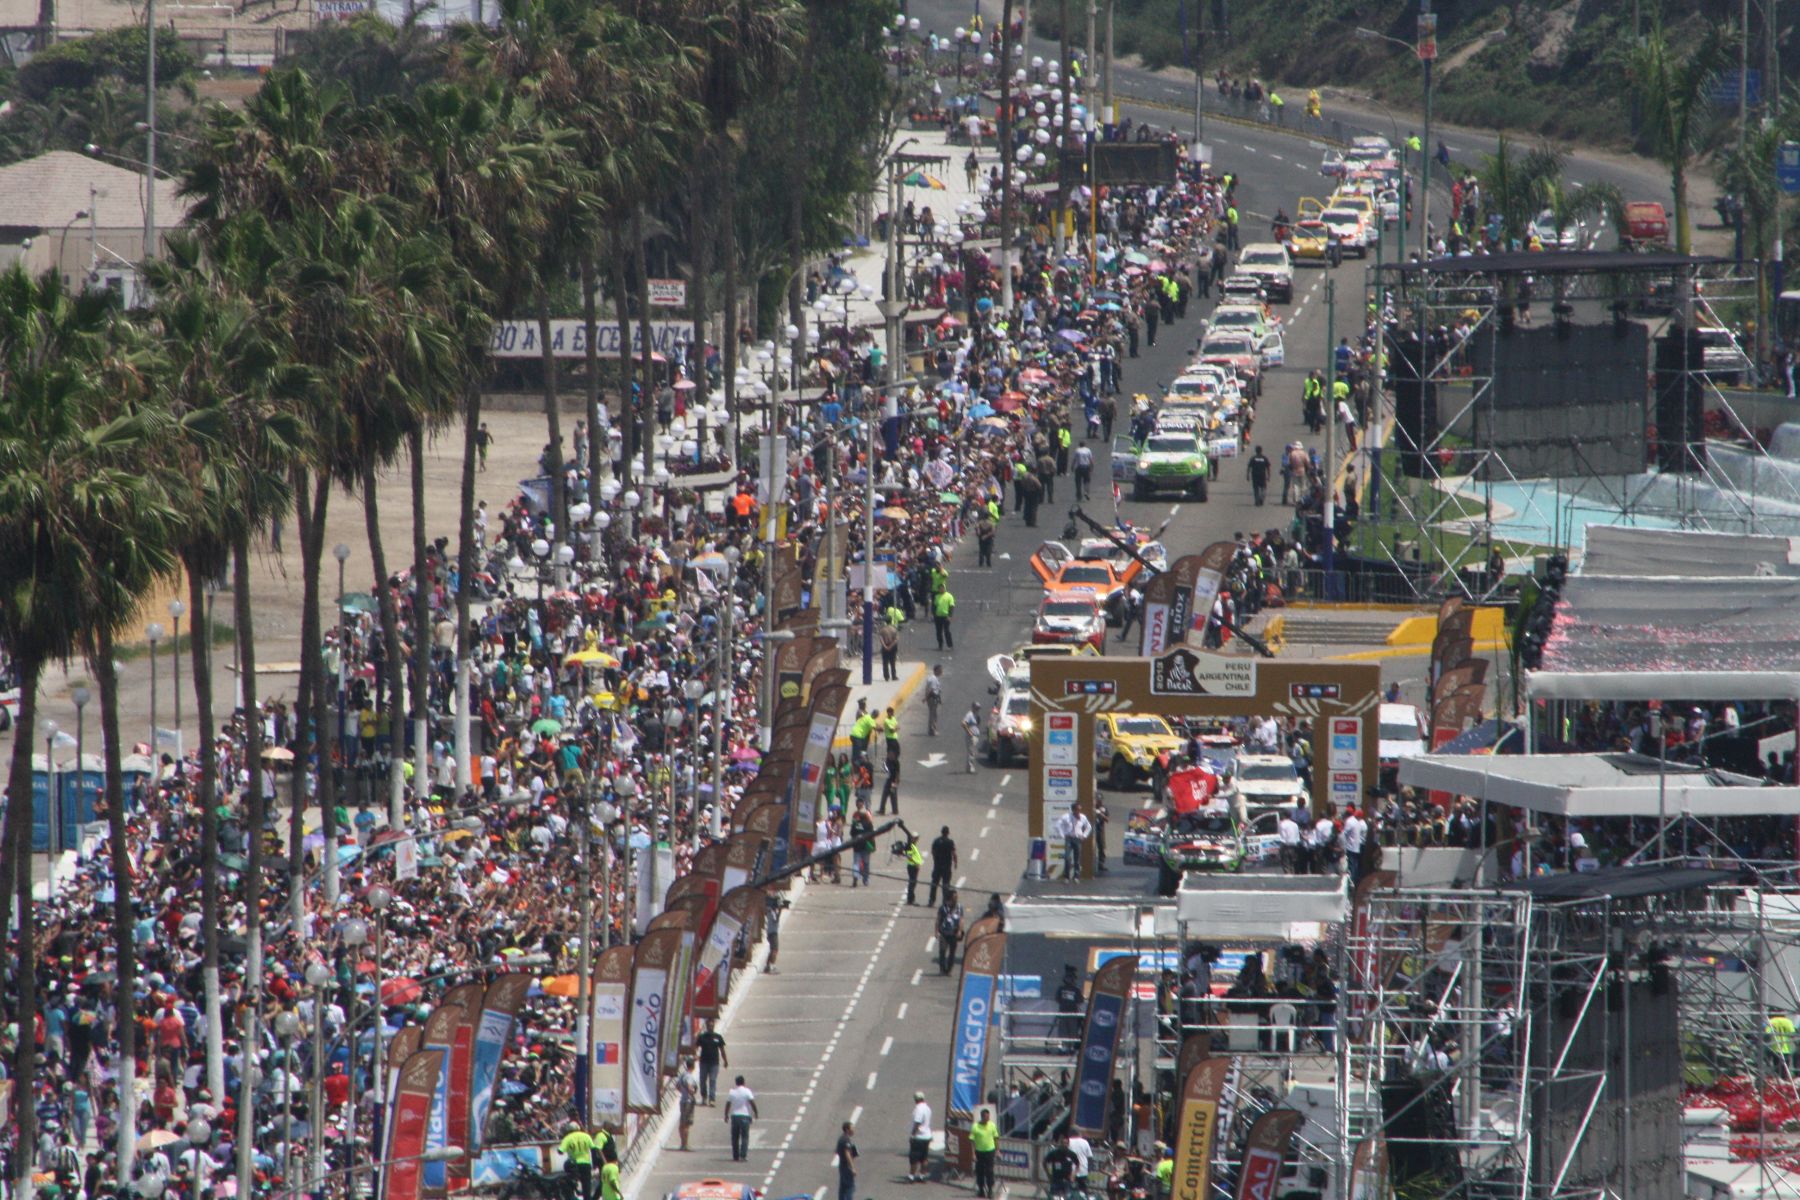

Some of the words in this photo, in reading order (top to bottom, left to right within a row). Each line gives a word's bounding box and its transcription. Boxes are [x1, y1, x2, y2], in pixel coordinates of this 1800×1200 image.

[572, 325, 691, 352] ECEENCIA
[1173, 592, 1185, 634] EDOX
[1200, 672, 1250, 681] ARGENTINA
[1225, 663, 1251, 671] PERU
[640, 993, 661, 1078] sodexo
[956, 997, 986, 1086] Macro
[1180, 1110, 1208, 1200] Comercio
